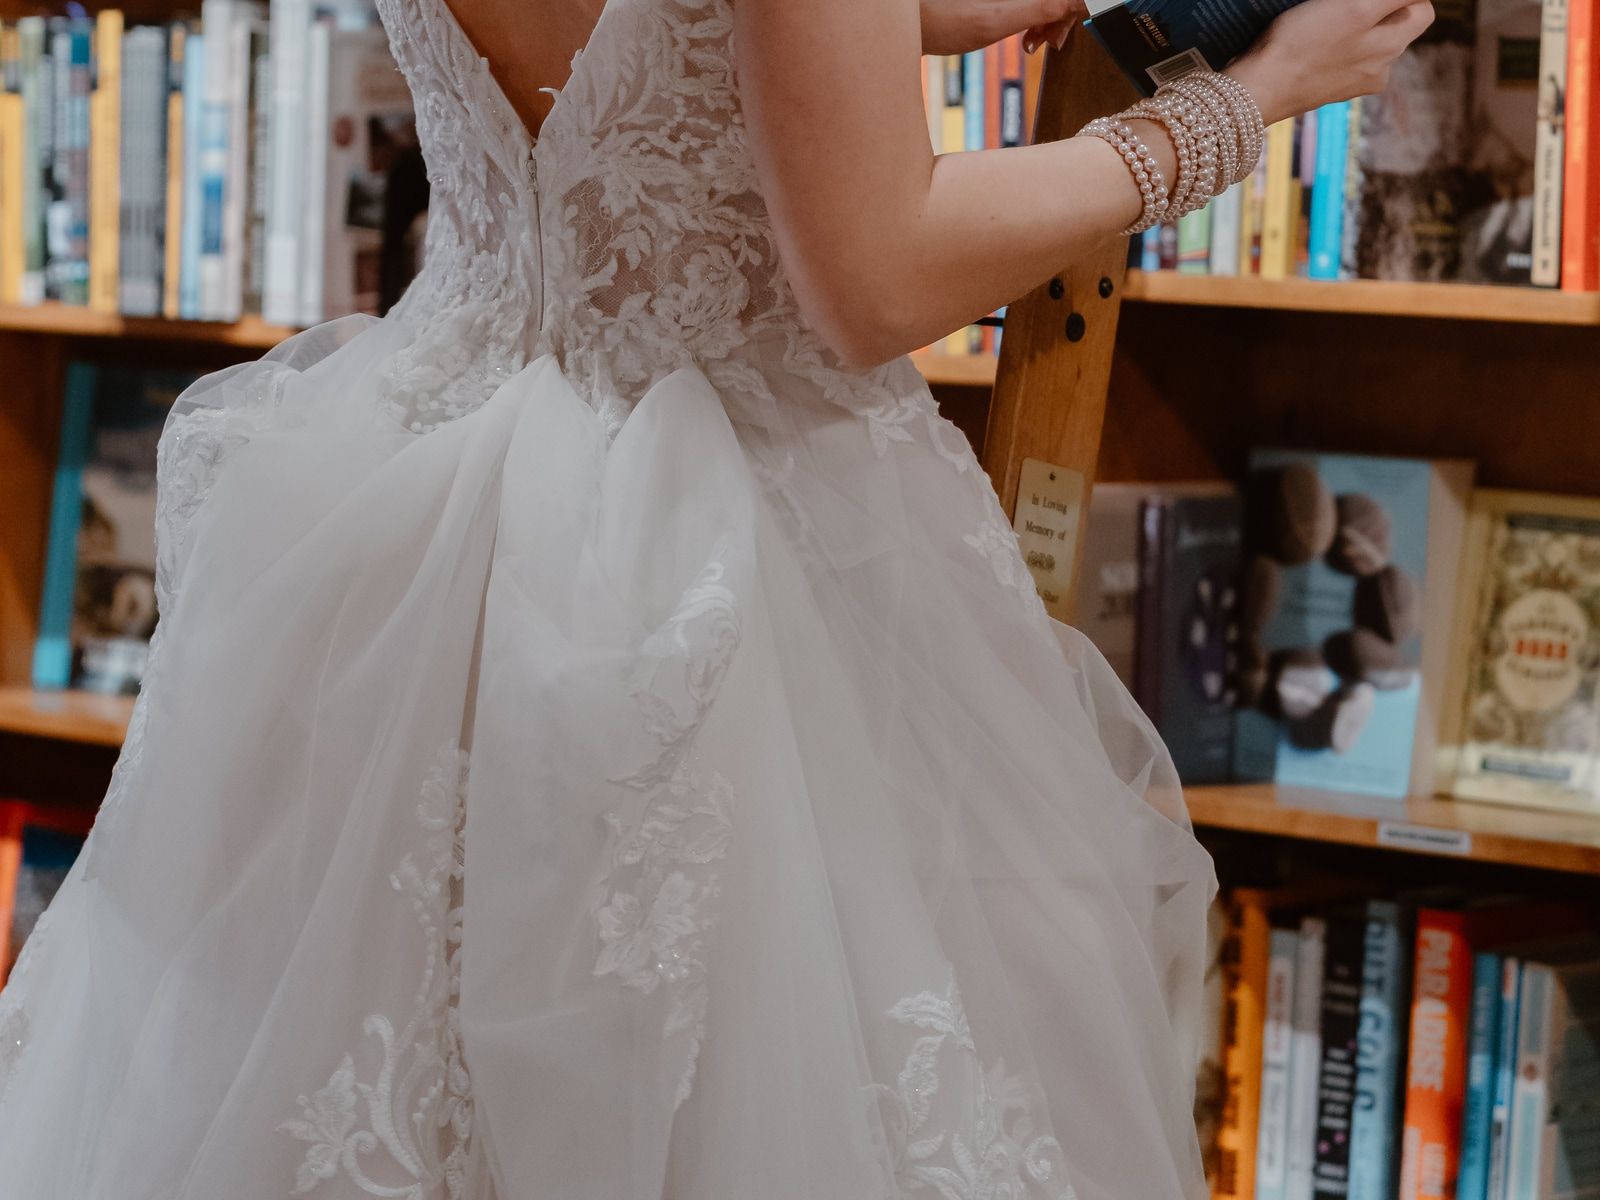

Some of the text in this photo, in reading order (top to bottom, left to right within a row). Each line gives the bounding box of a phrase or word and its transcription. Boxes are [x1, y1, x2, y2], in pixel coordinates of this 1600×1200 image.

[1042, 495, 1068, 515] Loving
[1025, 519, 1067, 541] Memory of
[1408, 927, 1453, 1093] PARADISE
